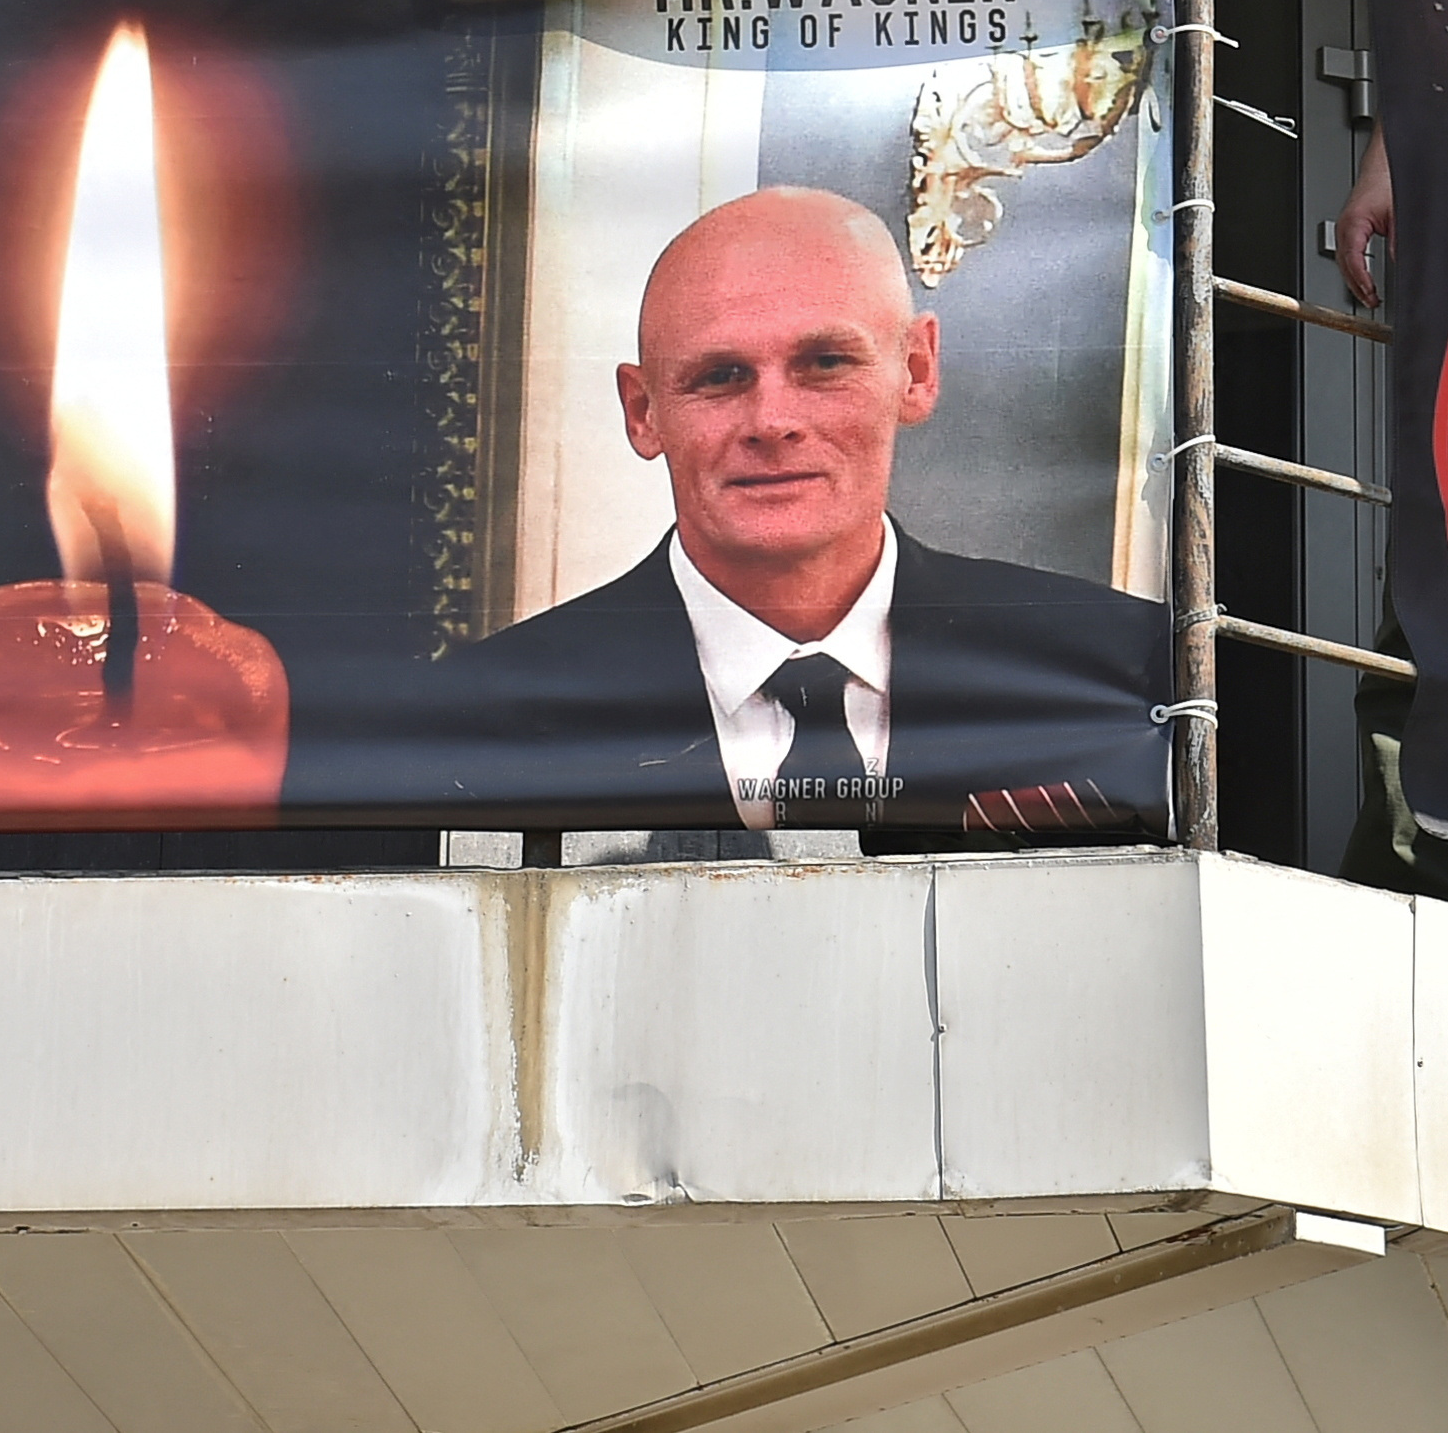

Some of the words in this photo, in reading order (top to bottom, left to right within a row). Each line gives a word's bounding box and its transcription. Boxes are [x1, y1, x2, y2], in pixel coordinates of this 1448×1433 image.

[666, 16, 770, 51] KING
[800, 13, 843, 48] OF
[875, 8, 1007, 47] KINGS
[738, 777, 826, 801] WAGNER
[836, 777, 904, 800] GROUP
